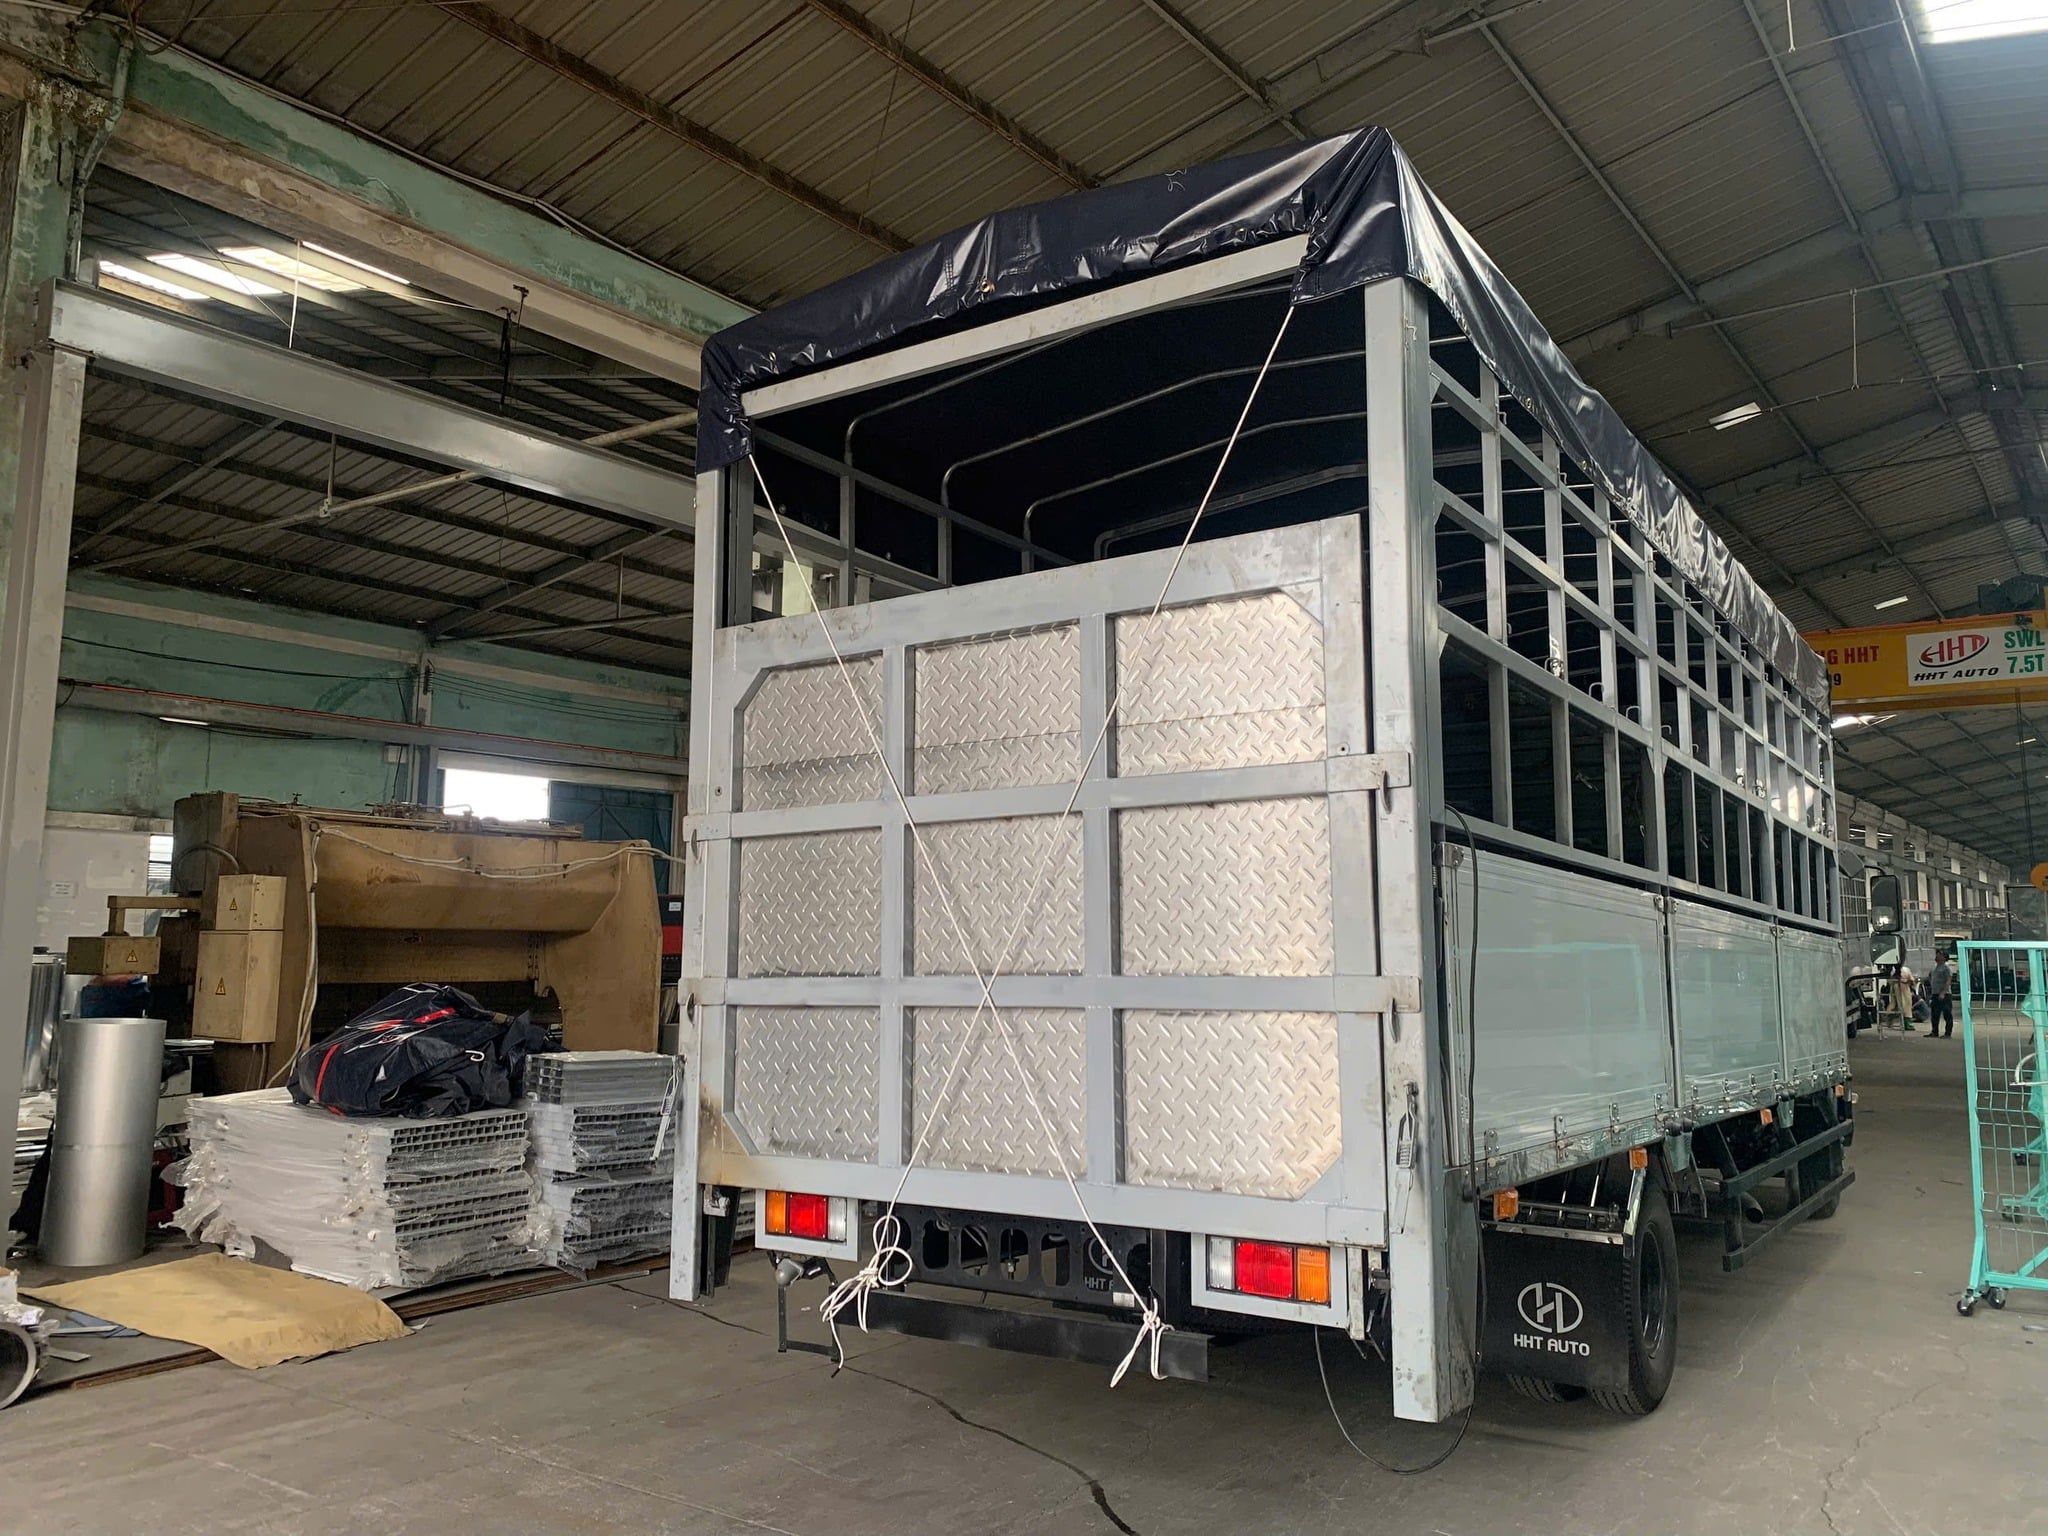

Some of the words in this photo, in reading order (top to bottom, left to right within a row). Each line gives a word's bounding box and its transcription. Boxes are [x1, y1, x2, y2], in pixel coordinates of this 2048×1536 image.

[2003, 629, 2046, 649] SWL
[1844, 646, 1880, 665] HHT
[2006, 654, 2046, 674] 7.5T
[1914, 670, 1949, 681] HHT
[1953, 667, 1999, 679] AUTO
[1084, 1276, 1107, 1290] HHT
[1513, 1333, 1544, 1350] HHT
[1547, 1338, 1590, 1357] AUTO
